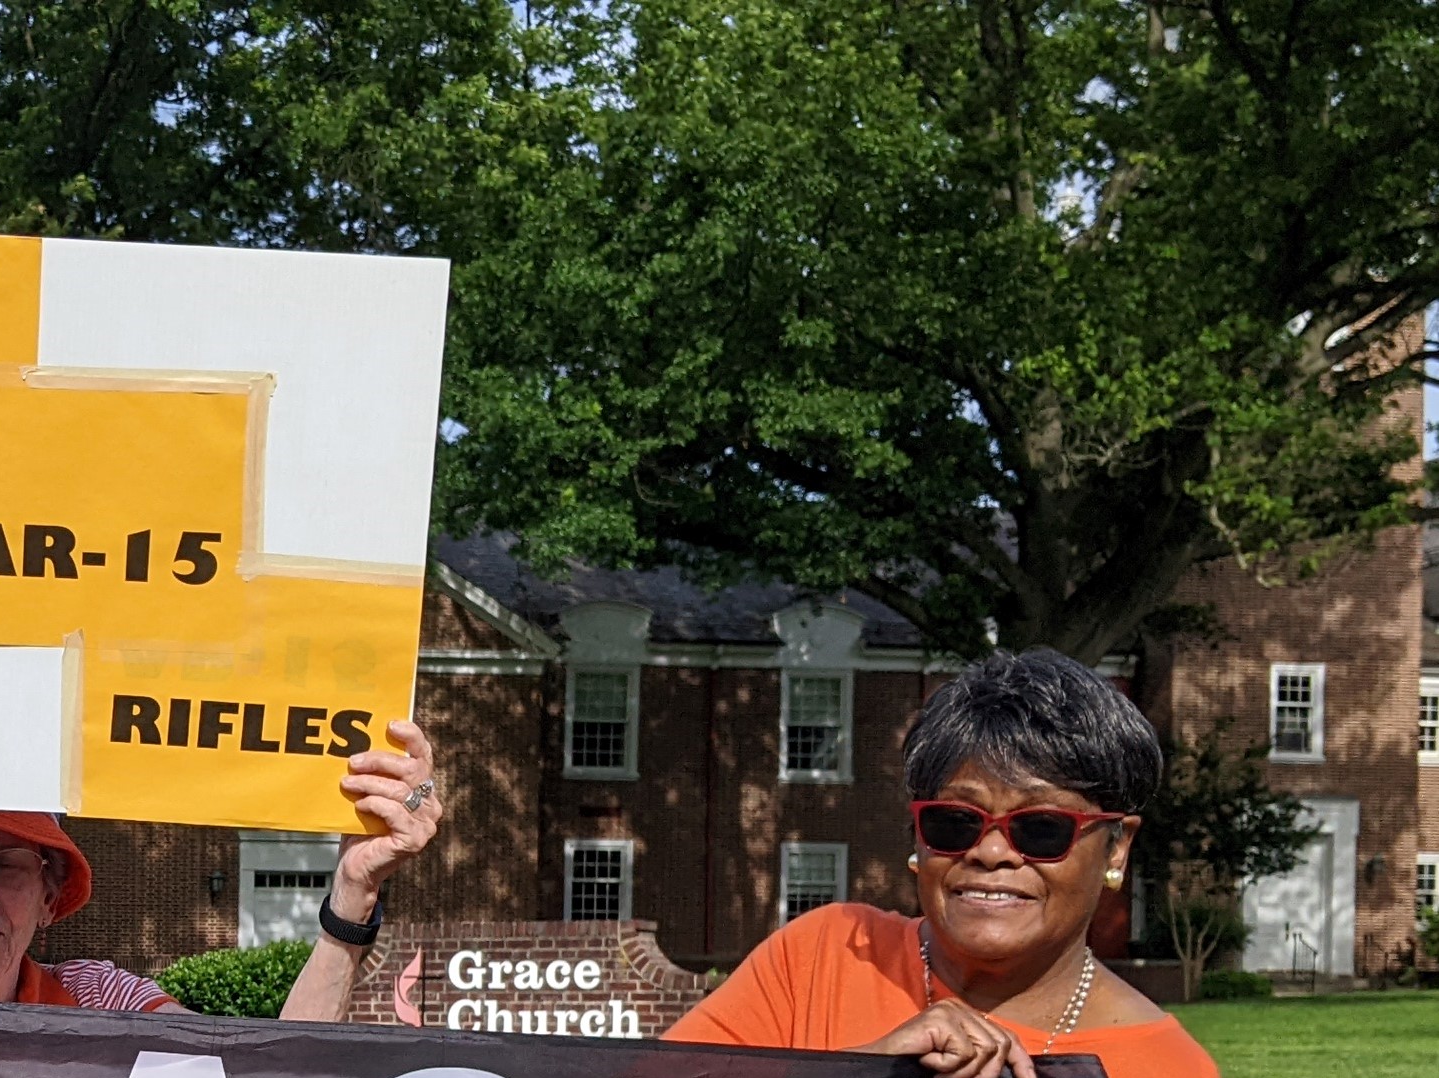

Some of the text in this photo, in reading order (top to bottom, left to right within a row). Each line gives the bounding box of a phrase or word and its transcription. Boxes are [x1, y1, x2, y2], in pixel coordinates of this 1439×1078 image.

[110, 693, 374, 758] RIFLES
[447, 950, 601, 991] Grace
[447, 998, 643, 1039] Church
